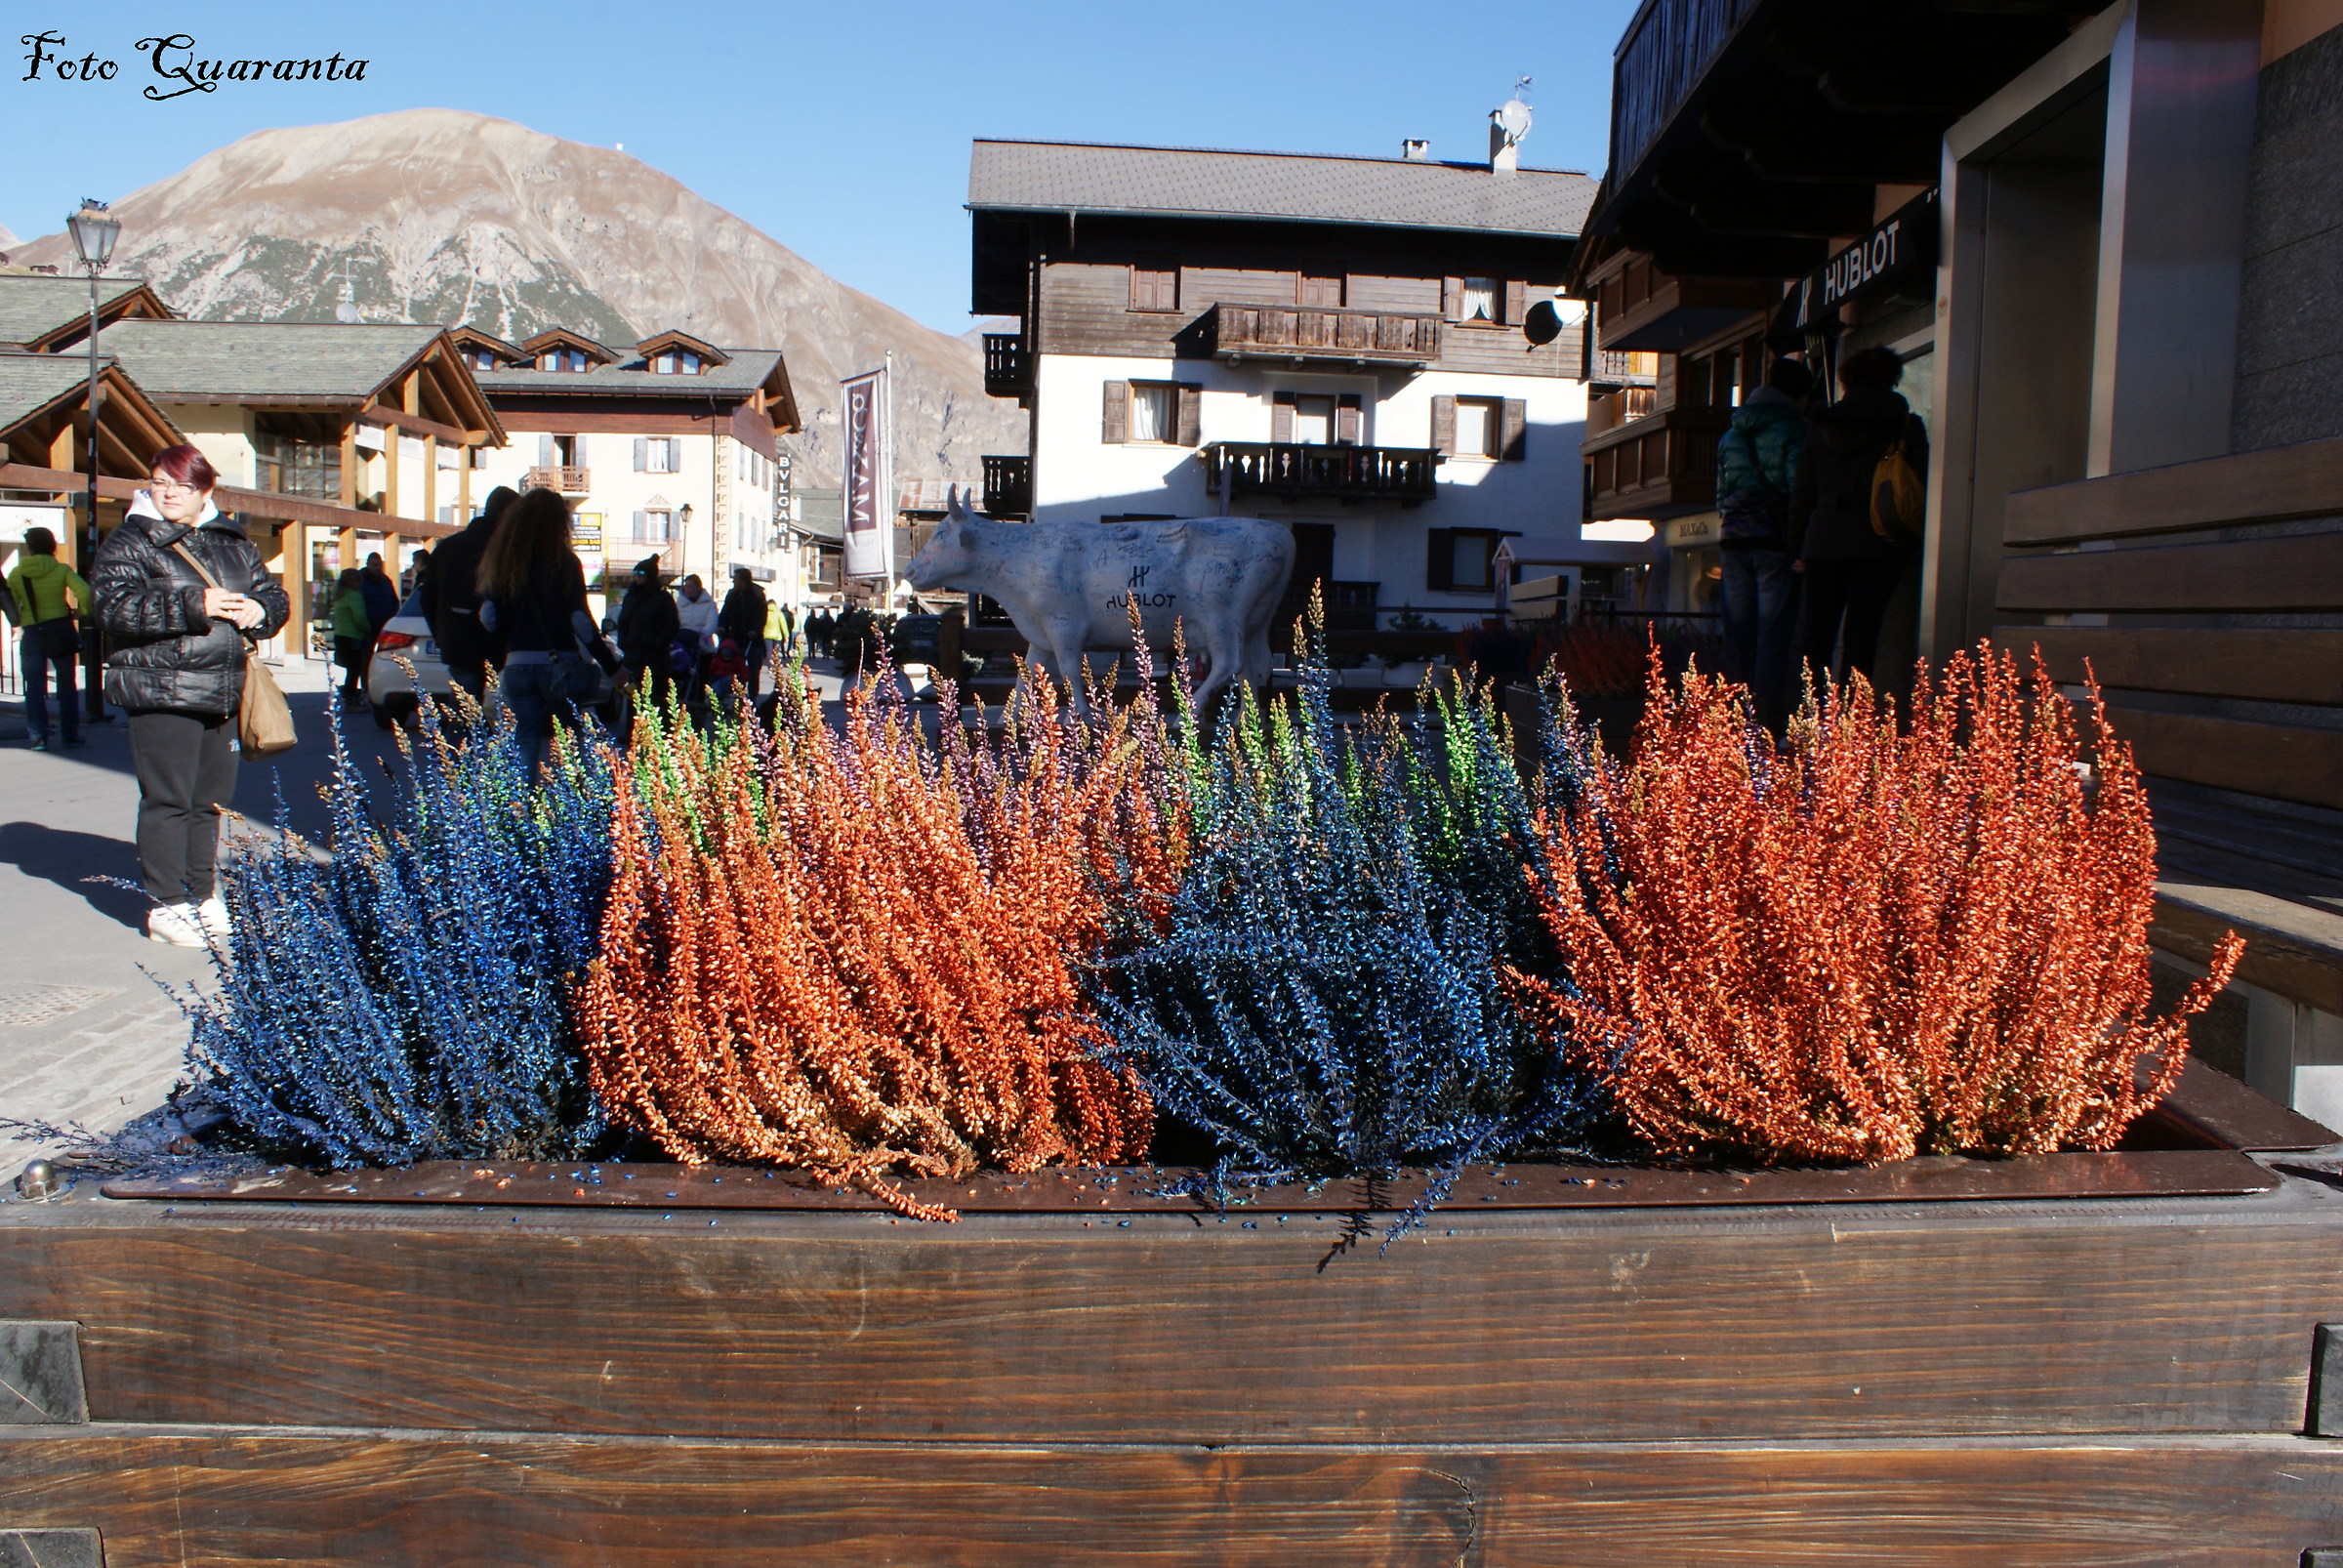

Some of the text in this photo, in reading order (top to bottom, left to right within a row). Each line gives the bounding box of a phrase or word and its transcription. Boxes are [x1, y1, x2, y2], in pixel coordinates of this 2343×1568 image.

[1824, 219, 1901, 306] HUBLOT
[777, 456, 791, 548] BVLGARI
[1106, 594, 1176, 609] HUBLOT
